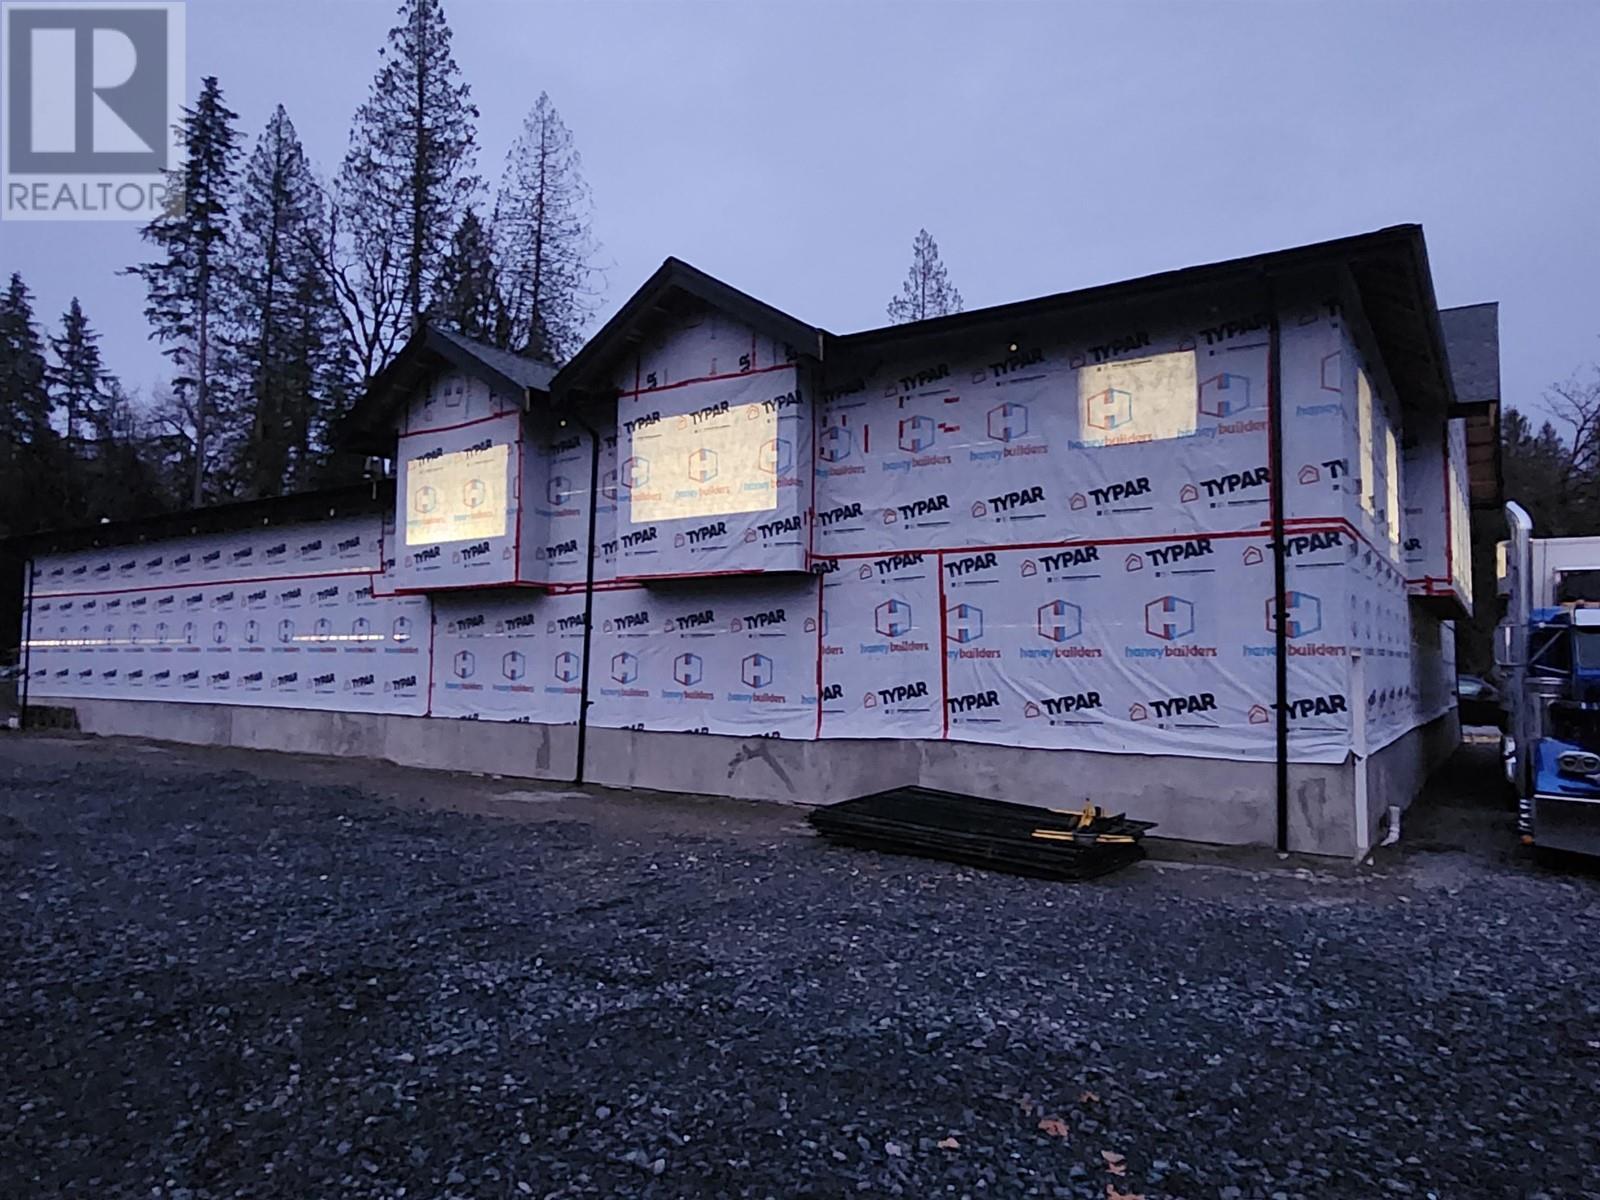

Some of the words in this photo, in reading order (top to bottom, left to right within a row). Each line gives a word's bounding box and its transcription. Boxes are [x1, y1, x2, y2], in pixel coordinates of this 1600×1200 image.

[623, 411, 662, 435] TYPAR
[690, 400, 730, 425] TYPAR
[1088, 477, 1152, 505] TYPAR
[1201, 467, 1271, 497] TYPAR
[900, 494, 950, 519] TYPAR
[988, 486, 1045, 512] TYPAR
[818, 503, 863, 526] TYPAR
[621, 526, 657, 548] TYPAR
[686, 522, 727, 544] TYPAR
[758, 516, 801, 539] TYPAR
[875, 553, 924, 575] TYPAR
[1039, 546, 1099, 572] TYPAR
[1146, 539, 1214, 566] TYPAR
[944, 552, 998, 578] TYPAR
[557, 612, 587, 631] TYPA
[614, 611, 649, 630] TYPAR
[676, 610, 714, 630] TYPAR
[743, 609, 786, 630] TYPAR
[1243, 644, 1347, 658] hanebuilders
[879, 681, 928, 704] TYPAR
[948, 691, 1000, 713] TYPAR
[1041, 691, 1102, 715] TYPAR
[1149, 693, 1217, 718] TYPAR
